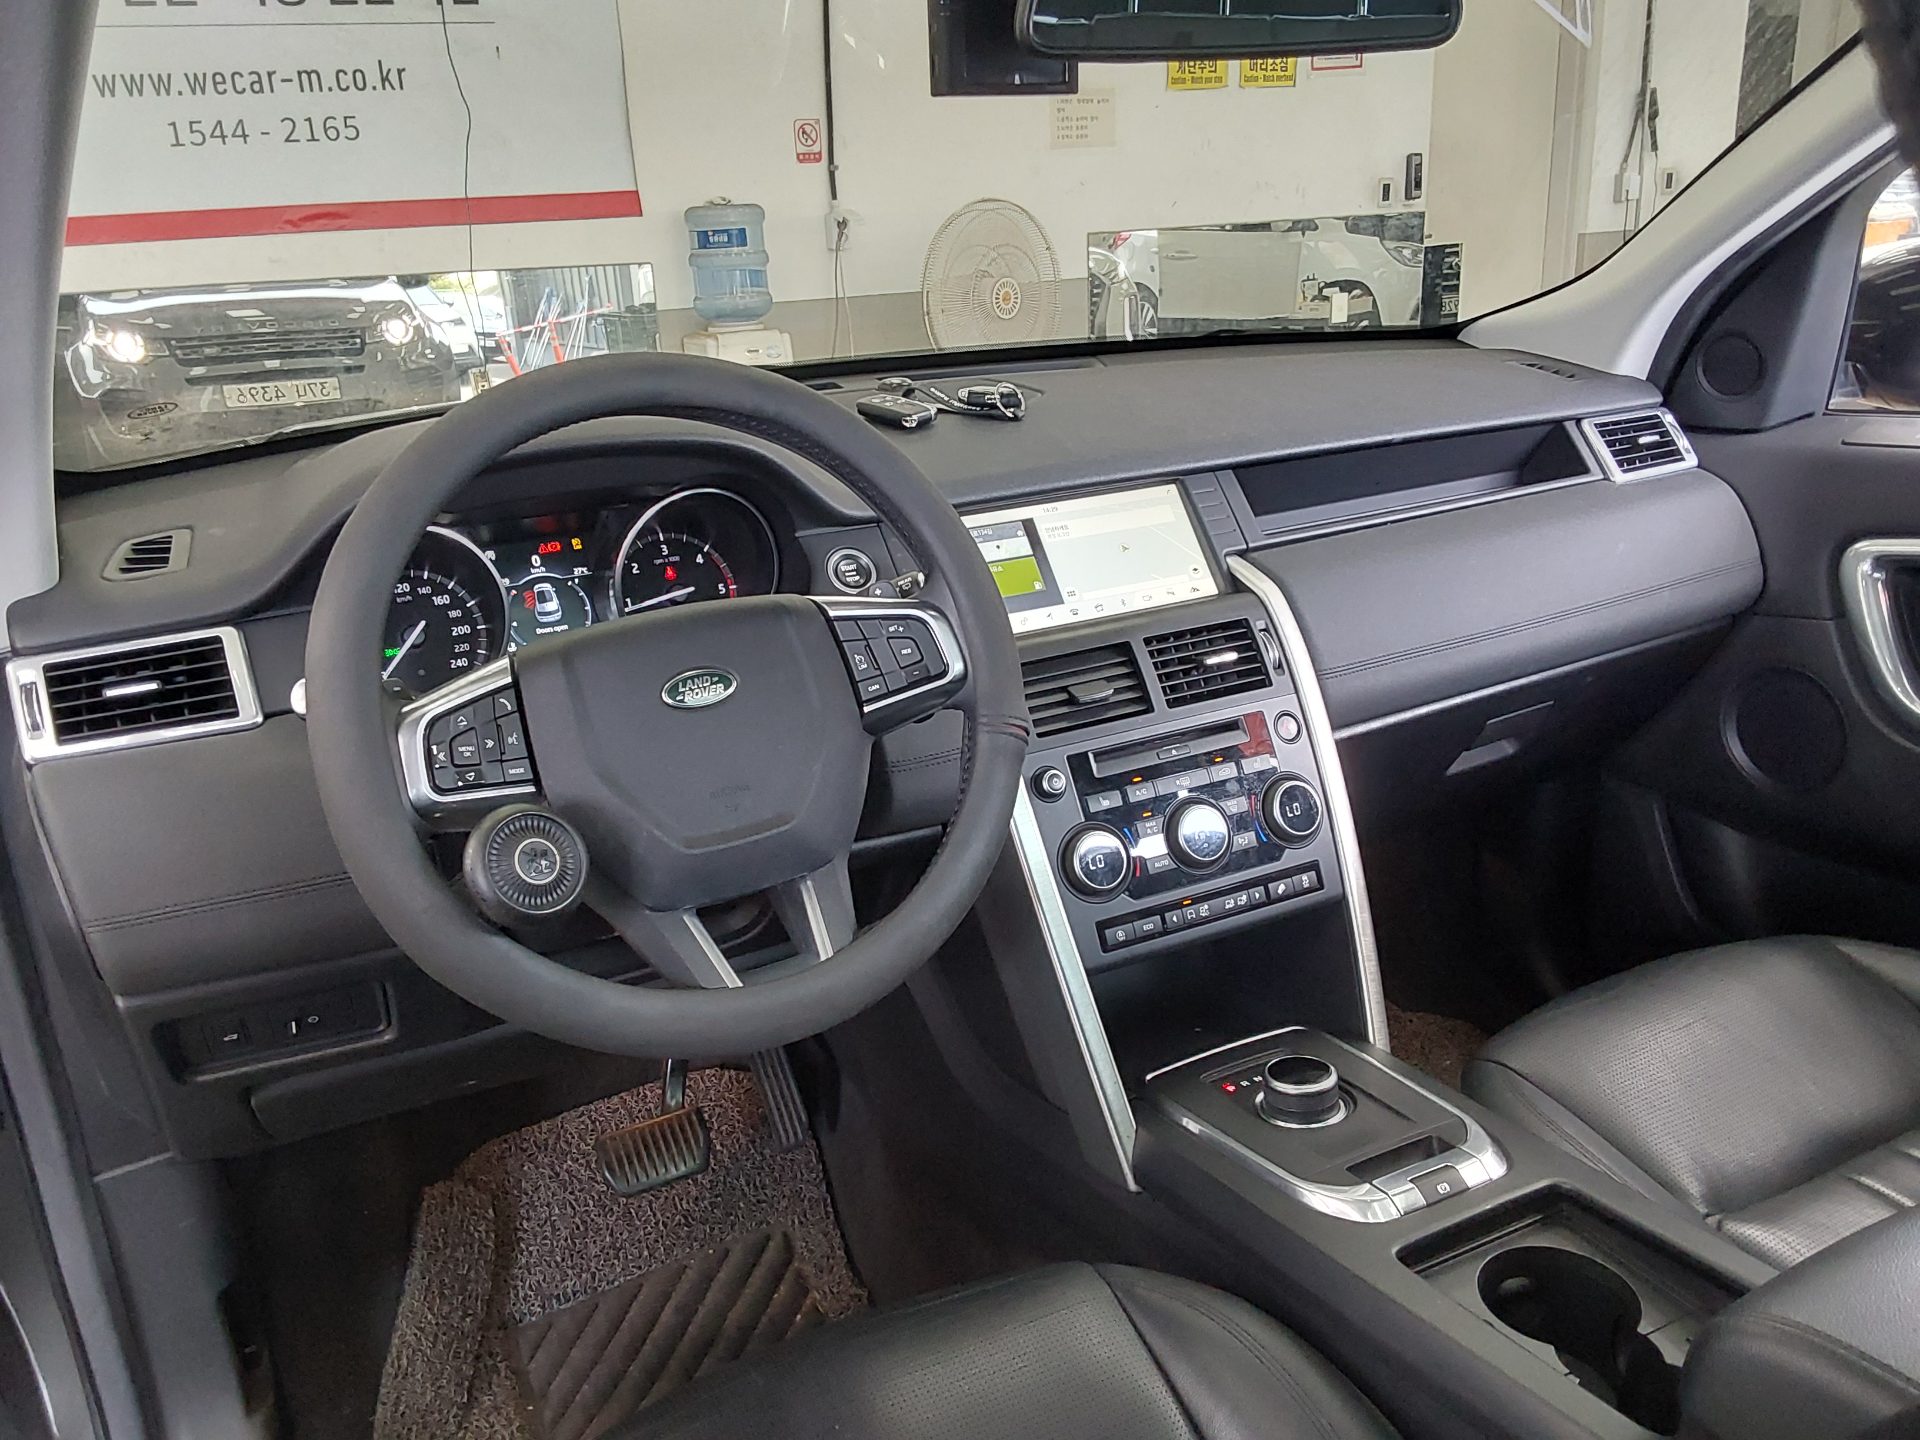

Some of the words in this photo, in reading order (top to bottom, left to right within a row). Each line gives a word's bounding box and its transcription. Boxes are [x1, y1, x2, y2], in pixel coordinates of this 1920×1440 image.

[92, 60, 407, 99] www.wecar-m.co.kr
[168, 119, 250, 148] 1544
[280, 115, 361, 143] 2165
[660, 545, 669, 556] 3
[531, 554, 541, 567] 0
[696, 554, 704, 564] 4
[631, 563, 640, 574] 2
[840, 564, 857, 572] START
[846, 575, 860, 583] STOP
[417, 586, 432, 595] 140
[718, 583, 726, 594] 5
[432, 594, 450, 606] 160
[447, 609, 462, 618] 180
[451, 624, 471, 636] 200
[536, 625, 553, 635] Doors
[554, 624, 569, 633] open
[454, 643, 470, 653] 220
[450, 657, 468, 669] 240
[679, 675, 711, 692] LAND
[868, 683, 880, 692] CAN
[684, 683, 725, 702] ROVER
[1135, 788, 1148, 796] A/C
[1286, 802, 1301, 818] LO
[1088, 854, 1105, 870] LO
[1154, 860, 1169, 868] AUTO
[1143, 922, 1154, 931] ECO
